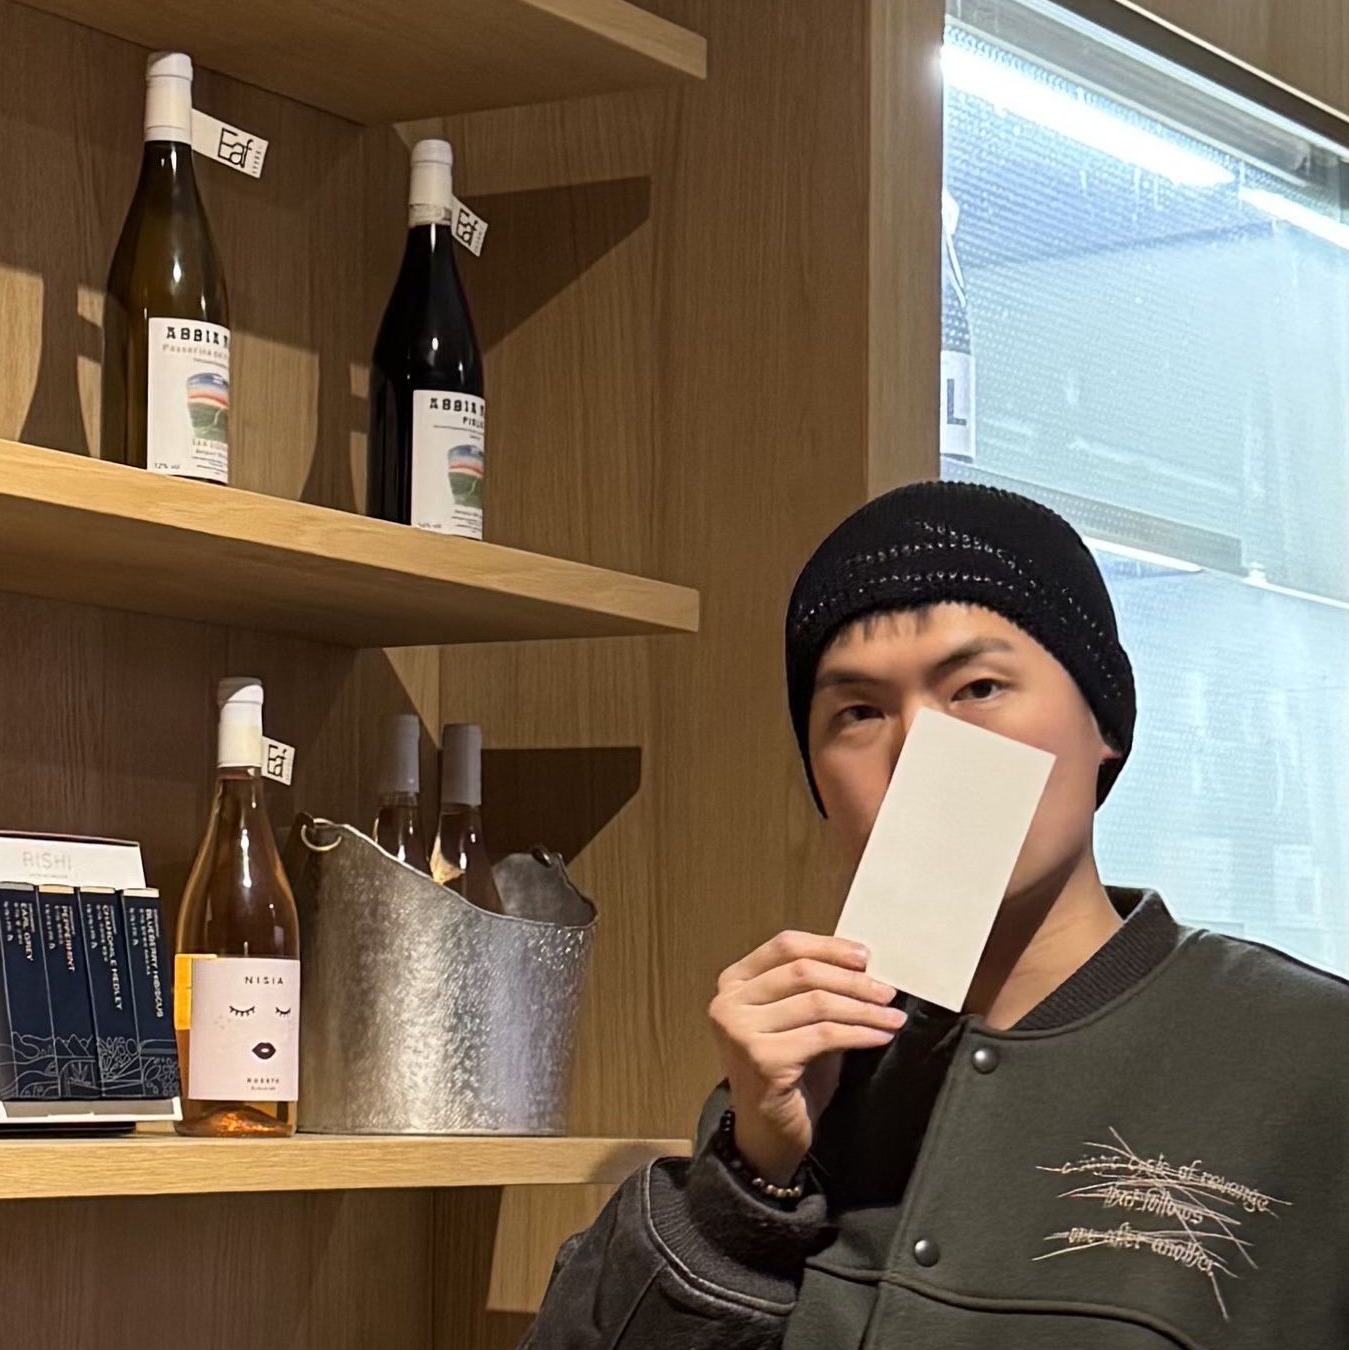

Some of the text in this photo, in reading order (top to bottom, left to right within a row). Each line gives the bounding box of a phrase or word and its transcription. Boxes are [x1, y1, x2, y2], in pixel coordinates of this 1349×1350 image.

[23, 850, 72, 871] RISHI
[244, 975, 284, 985] NISIA
[1178, 1159, 1203, 1180] of
[1151, 1237, 1214, 1272] another
